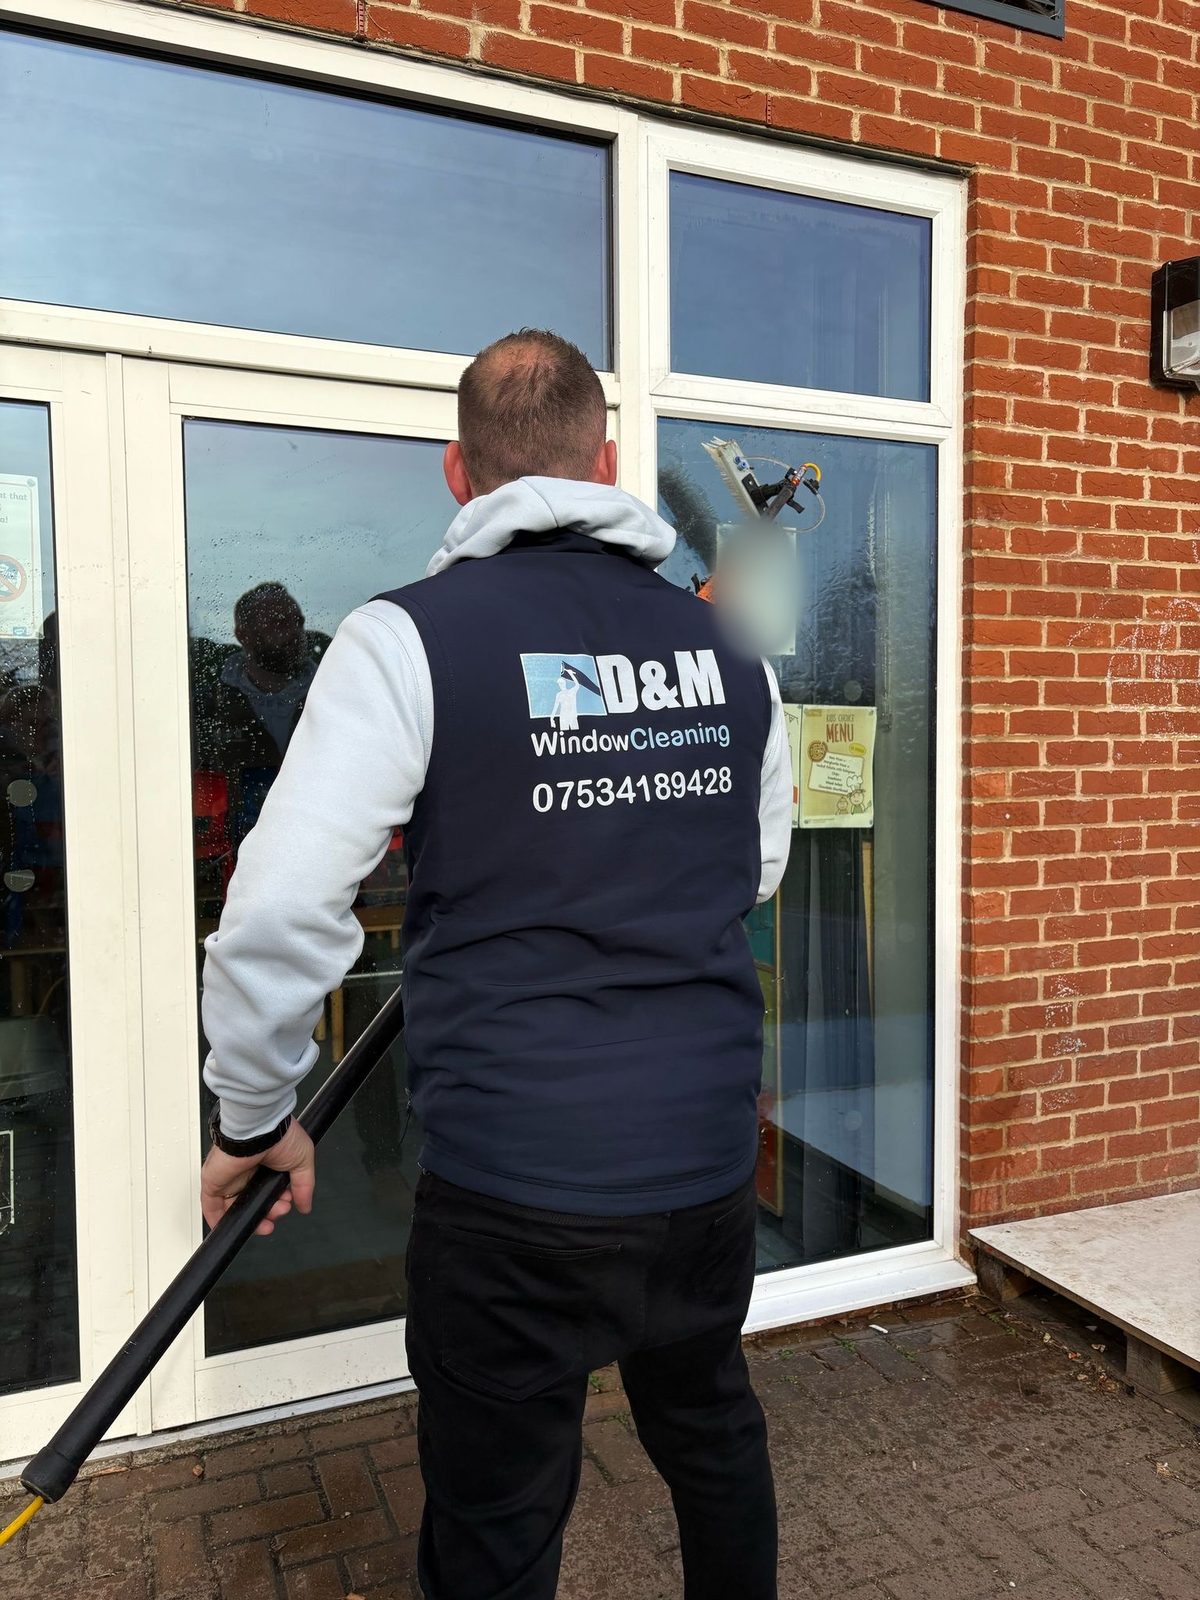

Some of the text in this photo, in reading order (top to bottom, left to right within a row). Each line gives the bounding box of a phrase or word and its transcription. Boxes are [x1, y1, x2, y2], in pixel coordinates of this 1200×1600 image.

[9, 492, 28, 500] that
[595, 649, 726, 714] D&M
[826, 723, 854, 743] MENU
[532, 766, 732, 813] 07534189428
